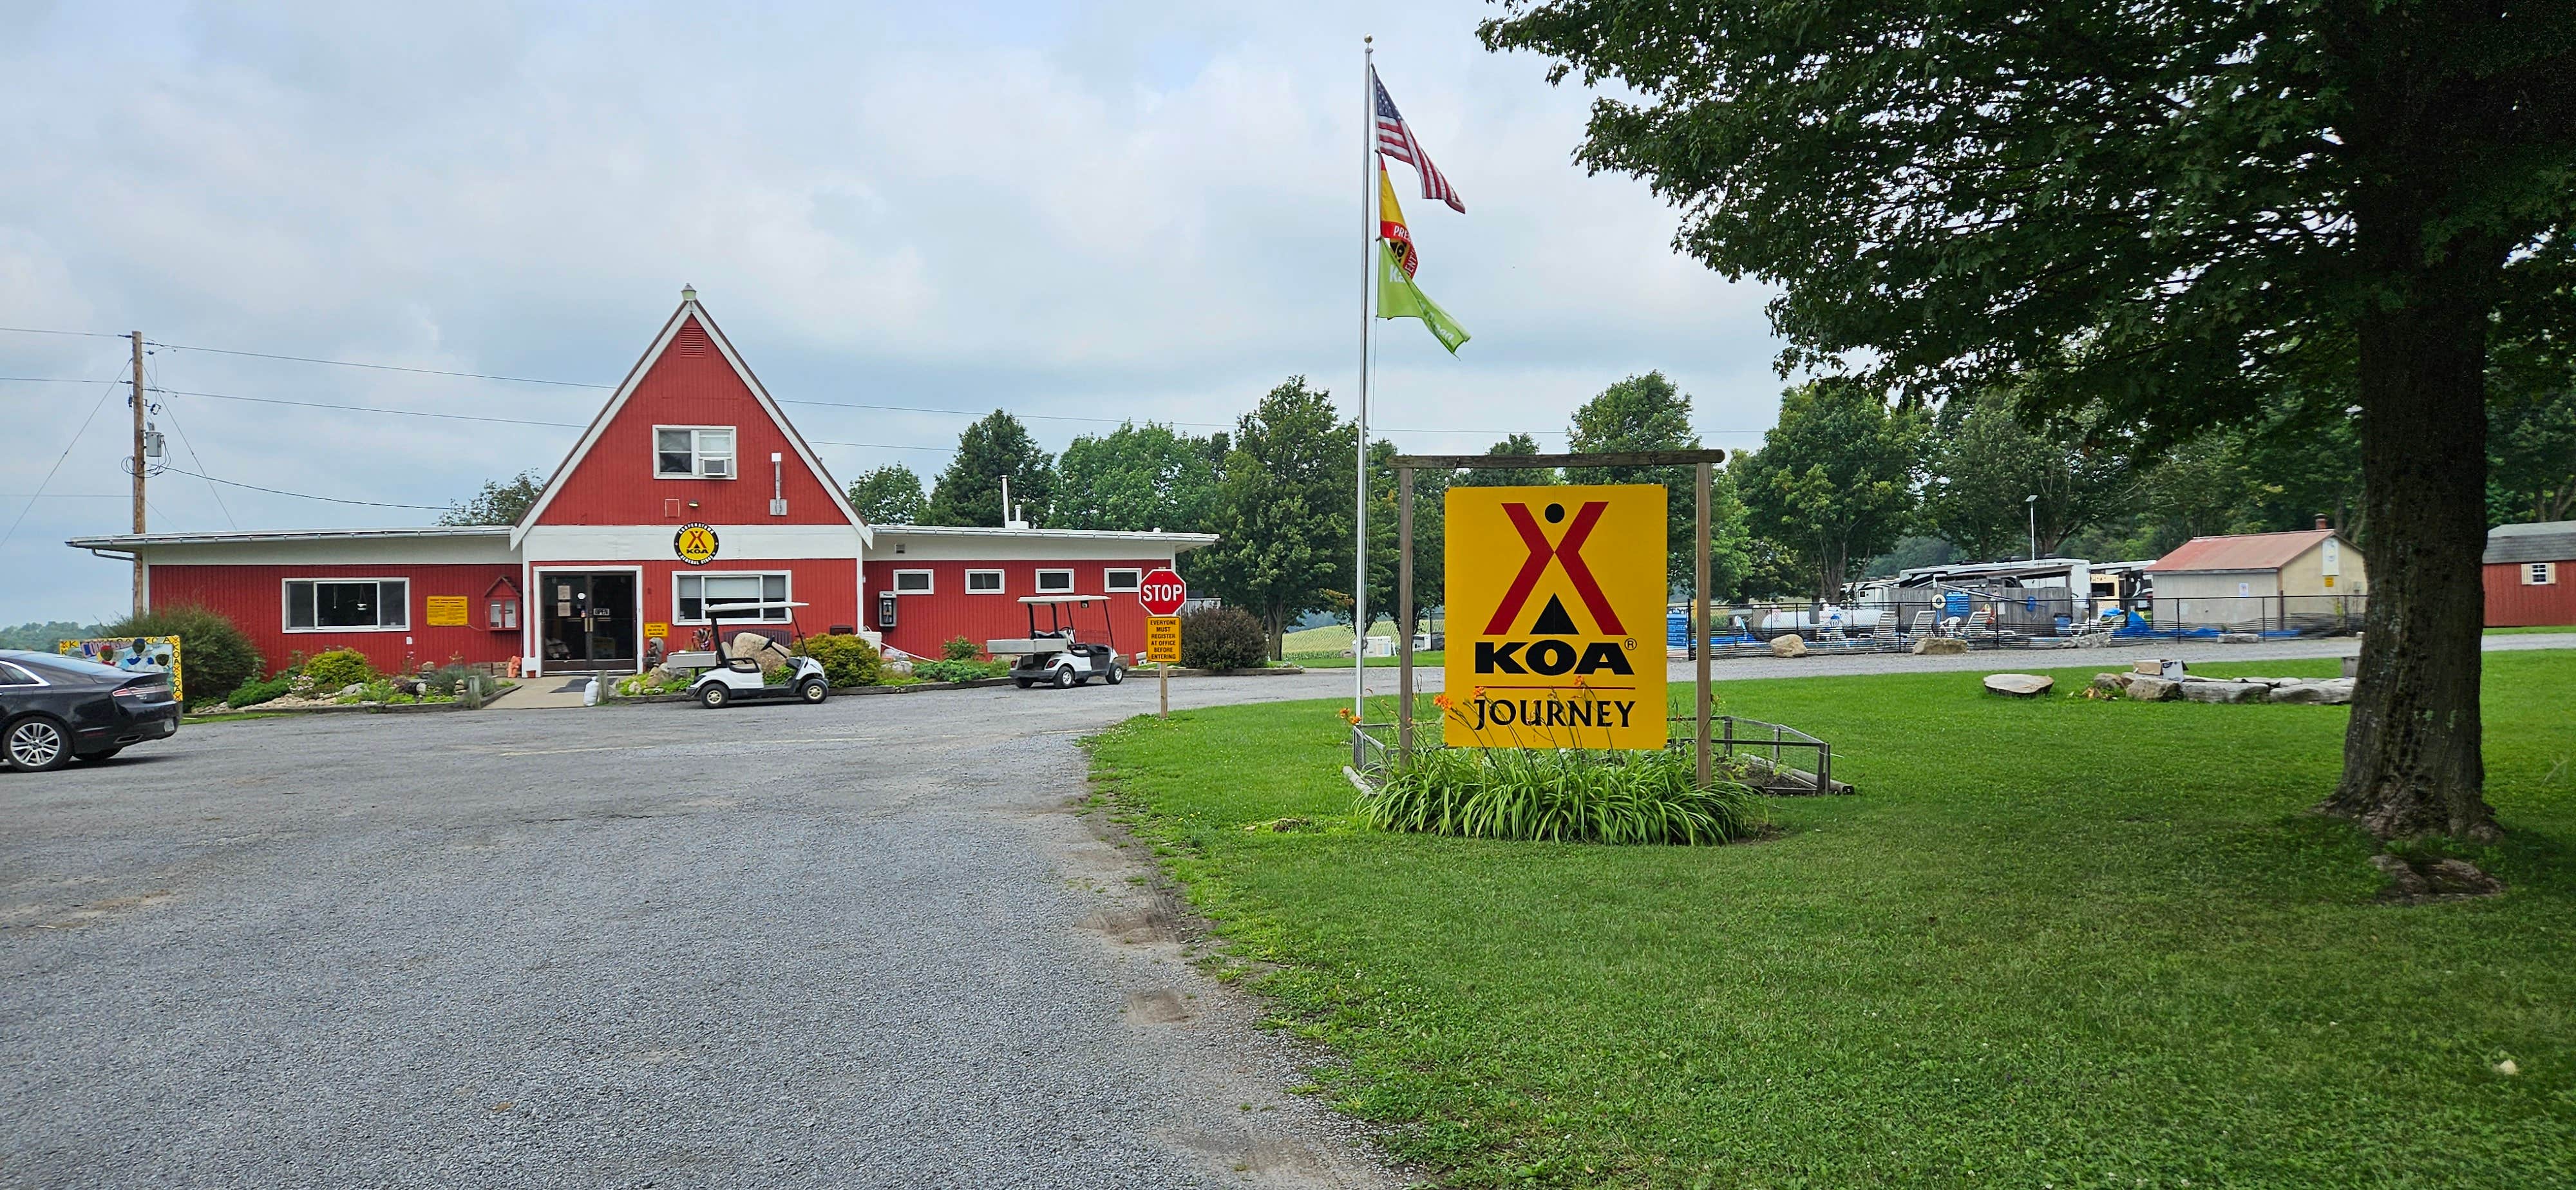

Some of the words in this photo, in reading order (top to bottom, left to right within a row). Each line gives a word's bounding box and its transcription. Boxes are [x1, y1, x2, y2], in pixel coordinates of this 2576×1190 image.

[1142, 584, 1182, 602] STOP
[1475, 639, 1635, 676] KOA
[1473, 699, 1636, 731] JOURNEY
